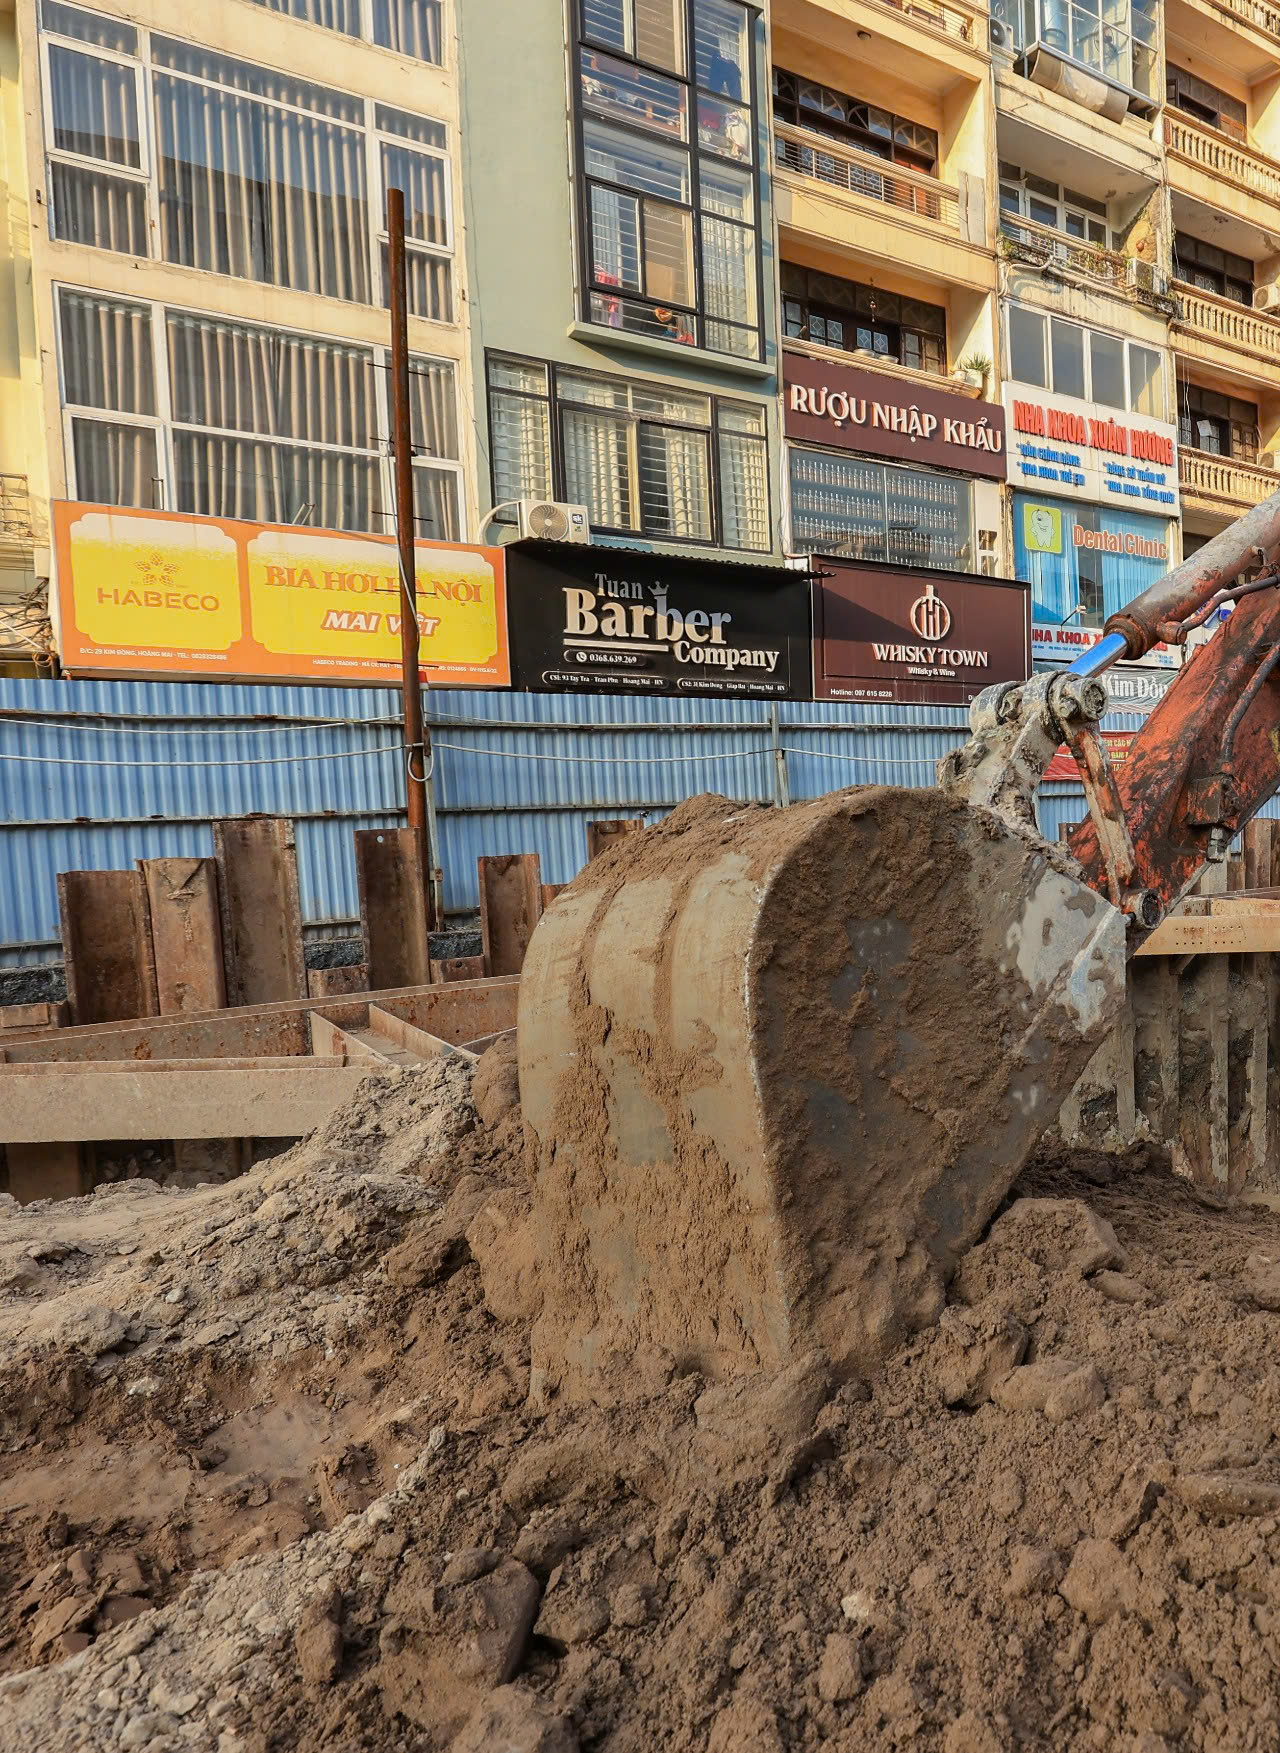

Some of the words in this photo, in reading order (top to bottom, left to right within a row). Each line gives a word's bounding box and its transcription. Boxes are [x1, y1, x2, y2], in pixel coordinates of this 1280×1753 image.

[789, 384, 867, 428] RƯỢU
[872, 404, 938, 443] NHẬP
[943, 416, 1003, 454] KHẨU
[1013, 399, 1046, 436] NHA
[1047, 408, 1087, 446] KHOA
[1073, 525, 1124, 554] Dental
[1124, 533, 1168, 560] Clinic
[264, 565, 318, 589] BIA
[432, 579, 484, 607] NỘI
[594, 572, 644, 600] Tuan
[96, 587, 220, 612] HABECO
[323, 611, 379, 632] MAI
[562, 586, 732, 645] Barber
[1056, 630, 1091, 645] KHOA
[589, 653, 638, 665] 0368.639.269
[672, 640, 780, 673] Company
[872, 643, 936, 664] WHISKY
[937, 647, 988, 667] TOWN
[907, 666, 933, 677] Whisky
[938, 668, 956, 677] Wine
[830, 688, 854, 696] Hotline:
[1101, 673, 1135, 698] Kim
